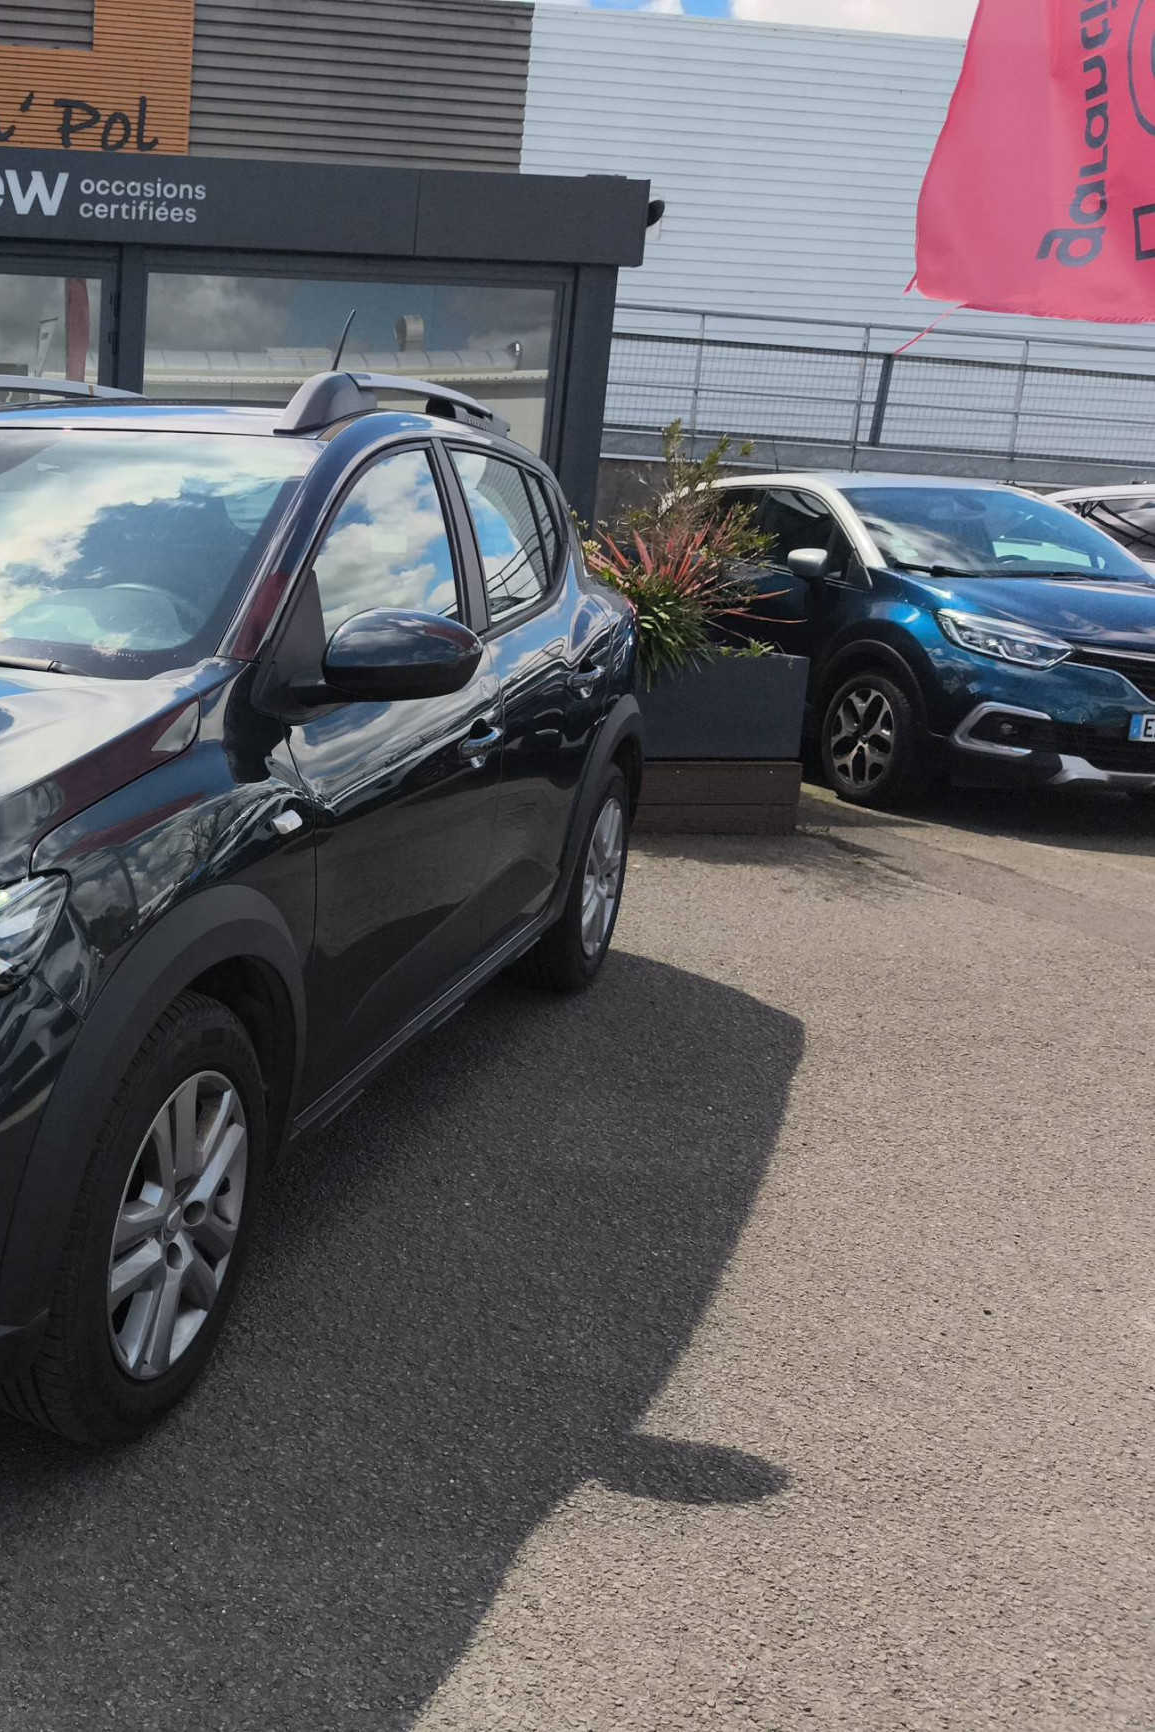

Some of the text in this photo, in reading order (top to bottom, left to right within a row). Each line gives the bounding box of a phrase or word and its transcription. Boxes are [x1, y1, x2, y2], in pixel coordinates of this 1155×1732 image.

[54, 96, 159, 151] Pol
[79, 177, 207, 201] occasions
[79, 200, 197, 224] certifiées
[1143, 718, 1155, 738] E
